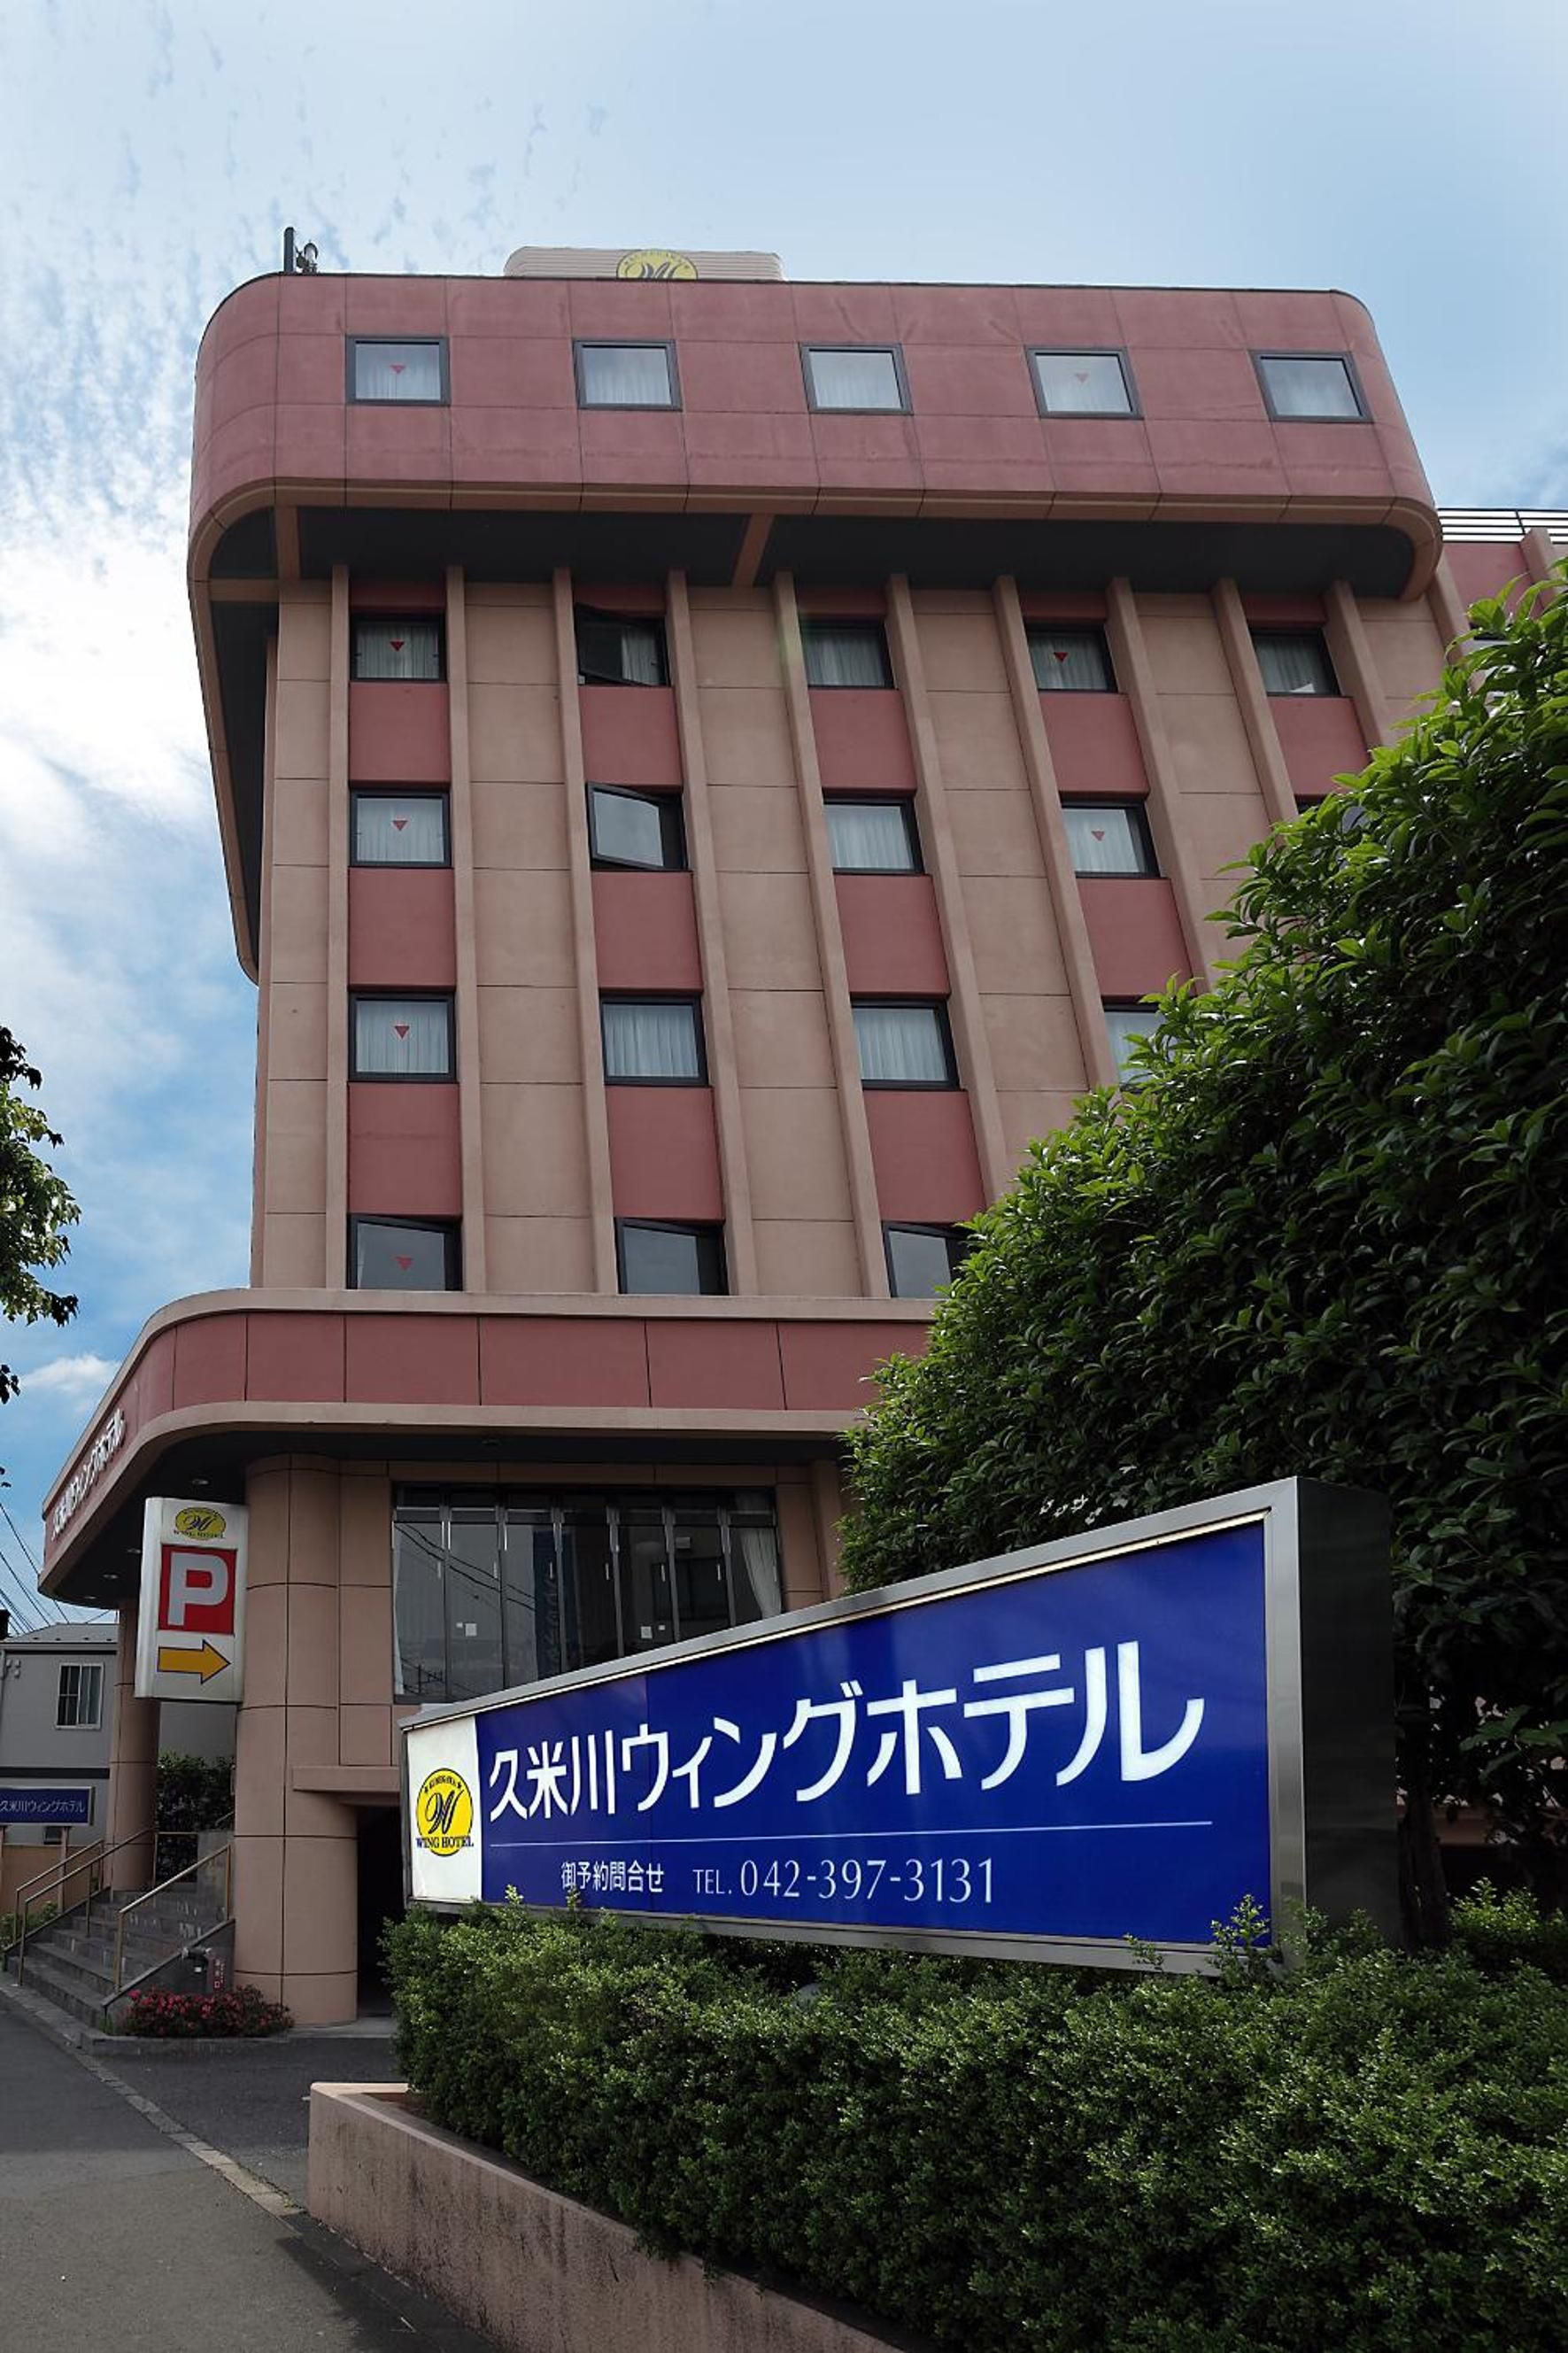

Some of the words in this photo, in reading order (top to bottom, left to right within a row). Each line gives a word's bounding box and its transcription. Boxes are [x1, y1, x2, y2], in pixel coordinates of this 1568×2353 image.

[167, 1552, 228, 1626] P
[490, 1641, 1205, 1822] 久米川ウィングホテル
[442, 1835, 475, 1848] HOTEL
[560, 1860, 664, 1892] 御予約問合せ
[692, 1869, 732, 1894] TEL.
[740, 1858, 992, 1903] 042-397-3131
